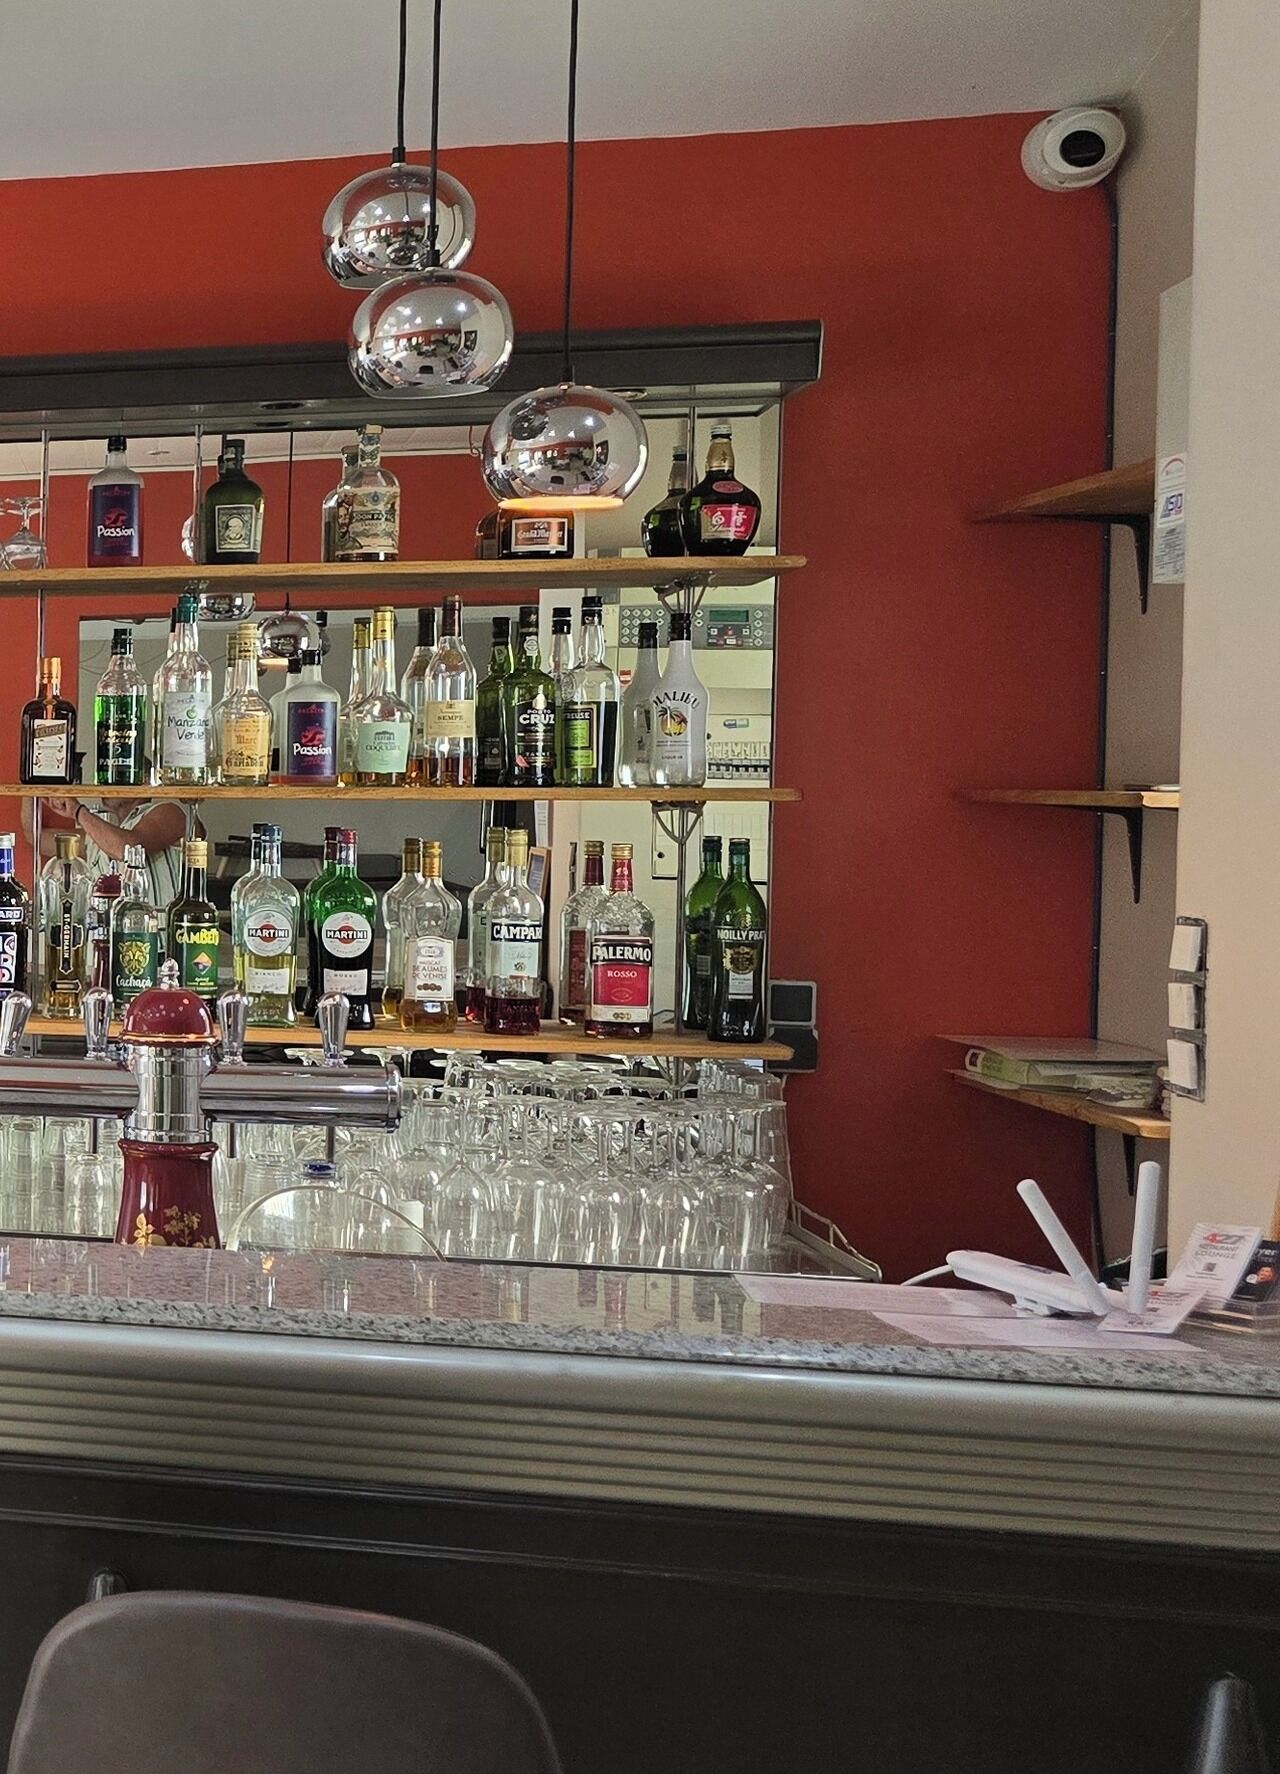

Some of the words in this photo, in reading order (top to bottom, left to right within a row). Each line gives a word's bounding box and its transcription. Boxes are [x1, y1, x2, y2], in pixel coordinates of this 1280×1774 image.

[96, 524, 136, 538] Passion
[653, 690, 701, 710] MALIBU
[519, 713, 555, 724] CRUZ
[293, 742, 332, 756] Passion
[248, 928, 289, 938] MARTINI
[326, 930, 368, 939] MARTINI
[493, 925, 543, 940] CAMPAR
[717, 929, 748, 941] NOILLY
[592, 945, 652, 962] PALERMO
[606, 970, 638, 978] ROSSO
